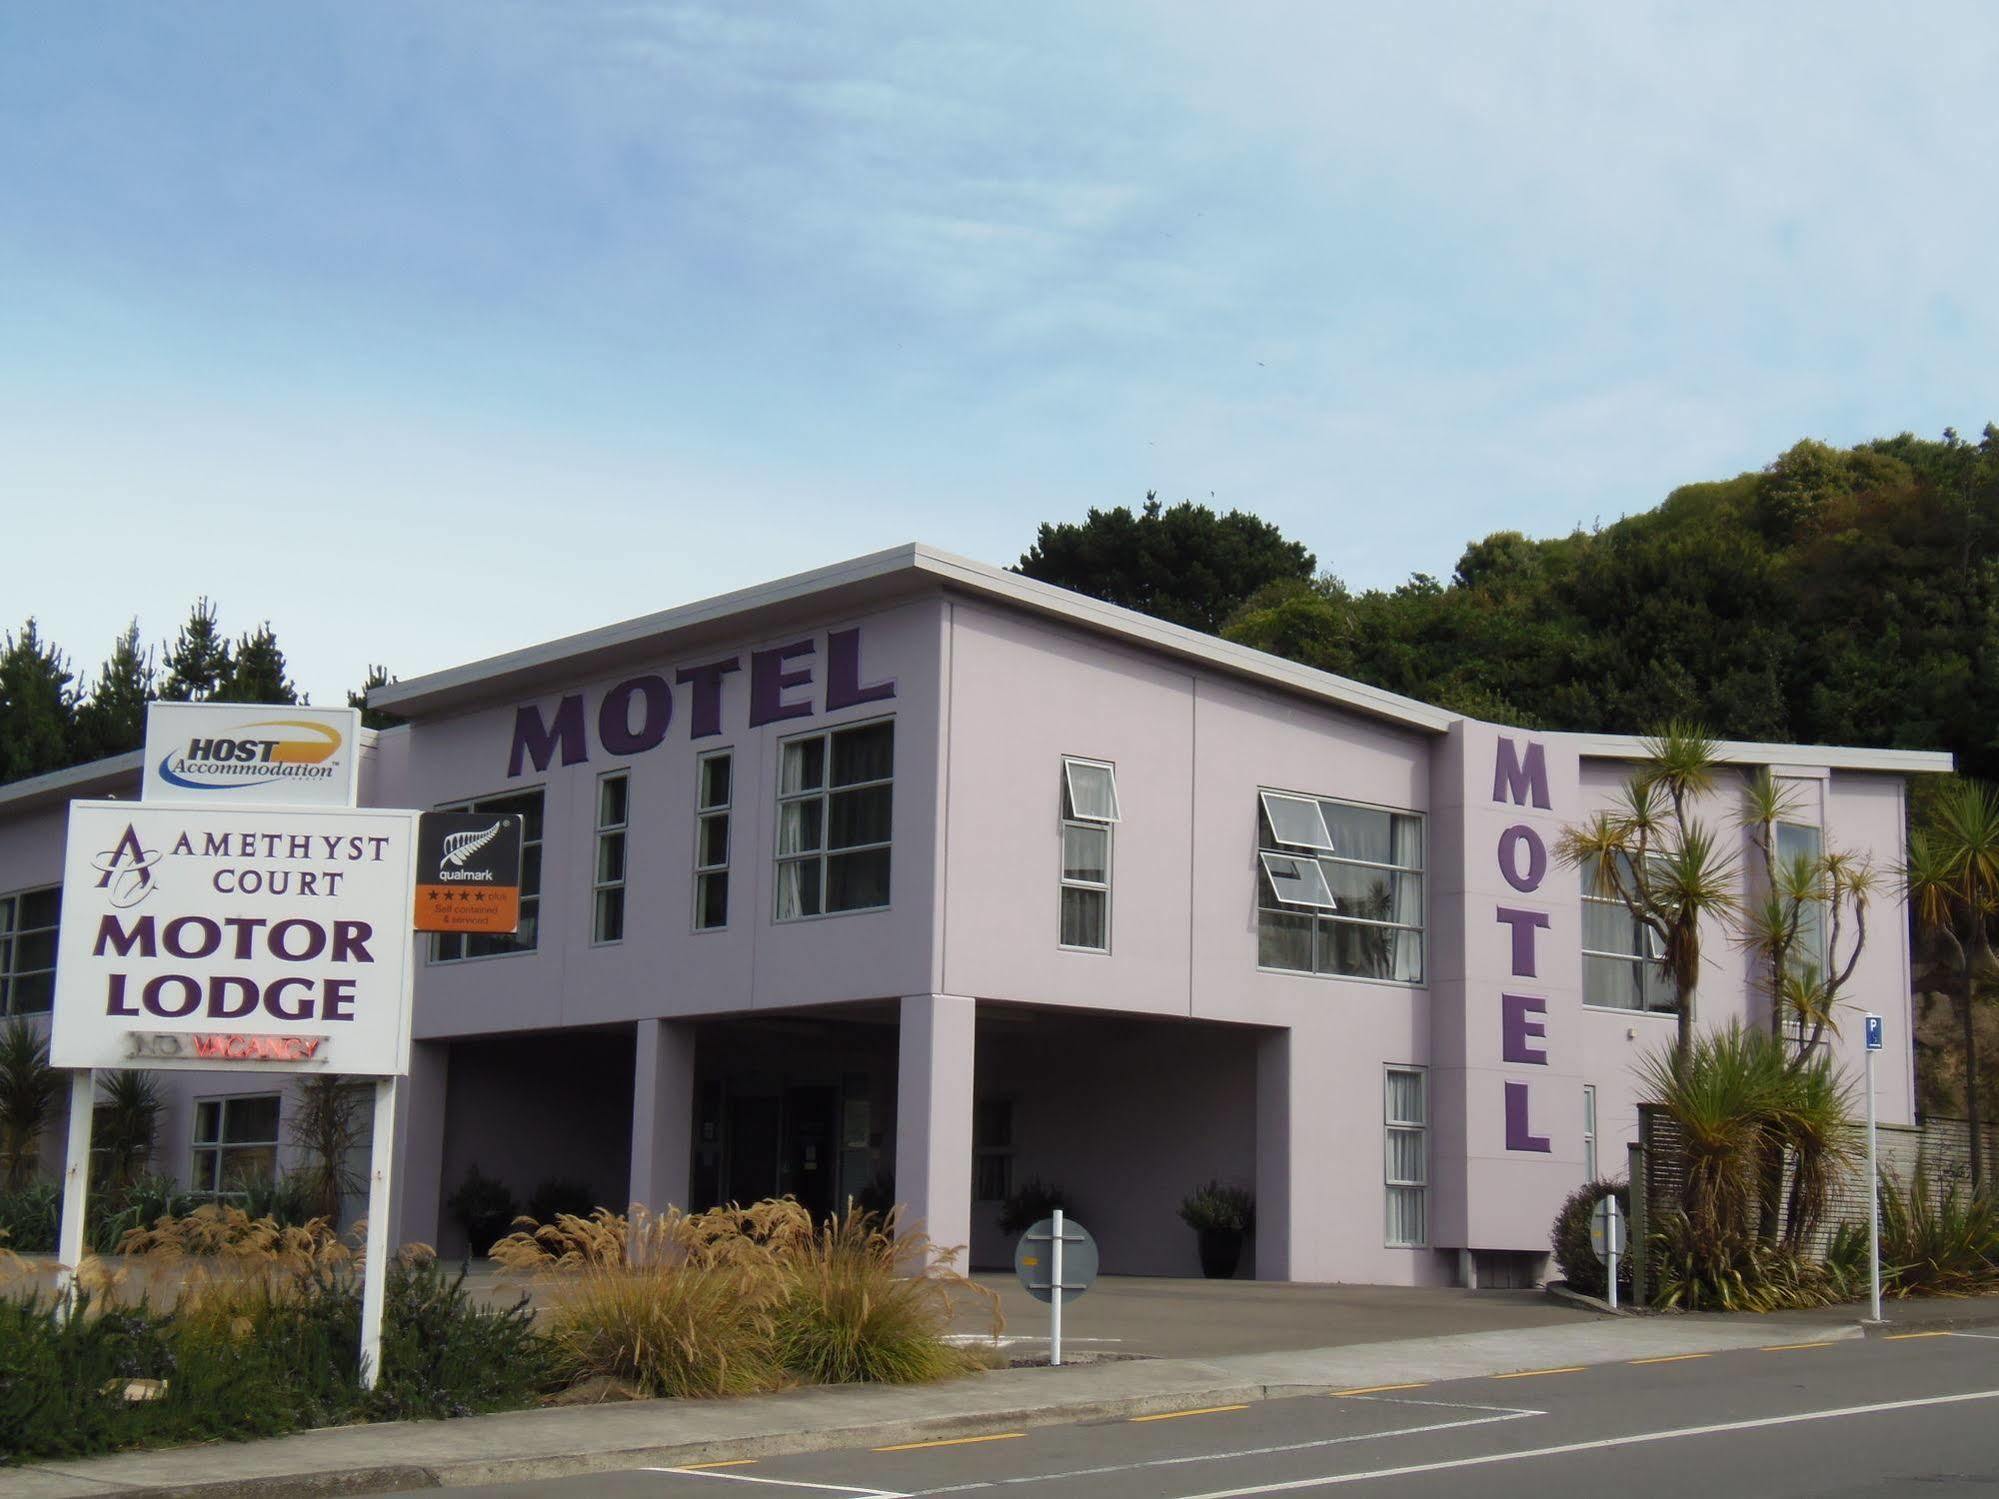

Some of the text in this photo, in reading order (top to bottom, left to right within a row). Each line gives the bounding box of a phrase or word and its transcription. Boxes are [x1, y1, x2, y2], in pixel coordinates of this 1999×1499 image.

[507, 627, 897, 778] MOTEL
[187, 737, 280, 763] HOST
[173, 759, 334, 778] Accommodation
[170, 830, 389, 861] AMETHYST
[212, 868, 344, 897] COURT
[440, 869, 493, 882] qualmark
[454, 904, 499, 915] contained
[92, 914, 374, 963] MOTOR
[1493, 735, 1552, 1154] MOTEL
[106, 973, 357, 1022] LODGE
[1870, 1019, 1877, 1031] P
[192, 1033, 320, 1059] VACANCY
